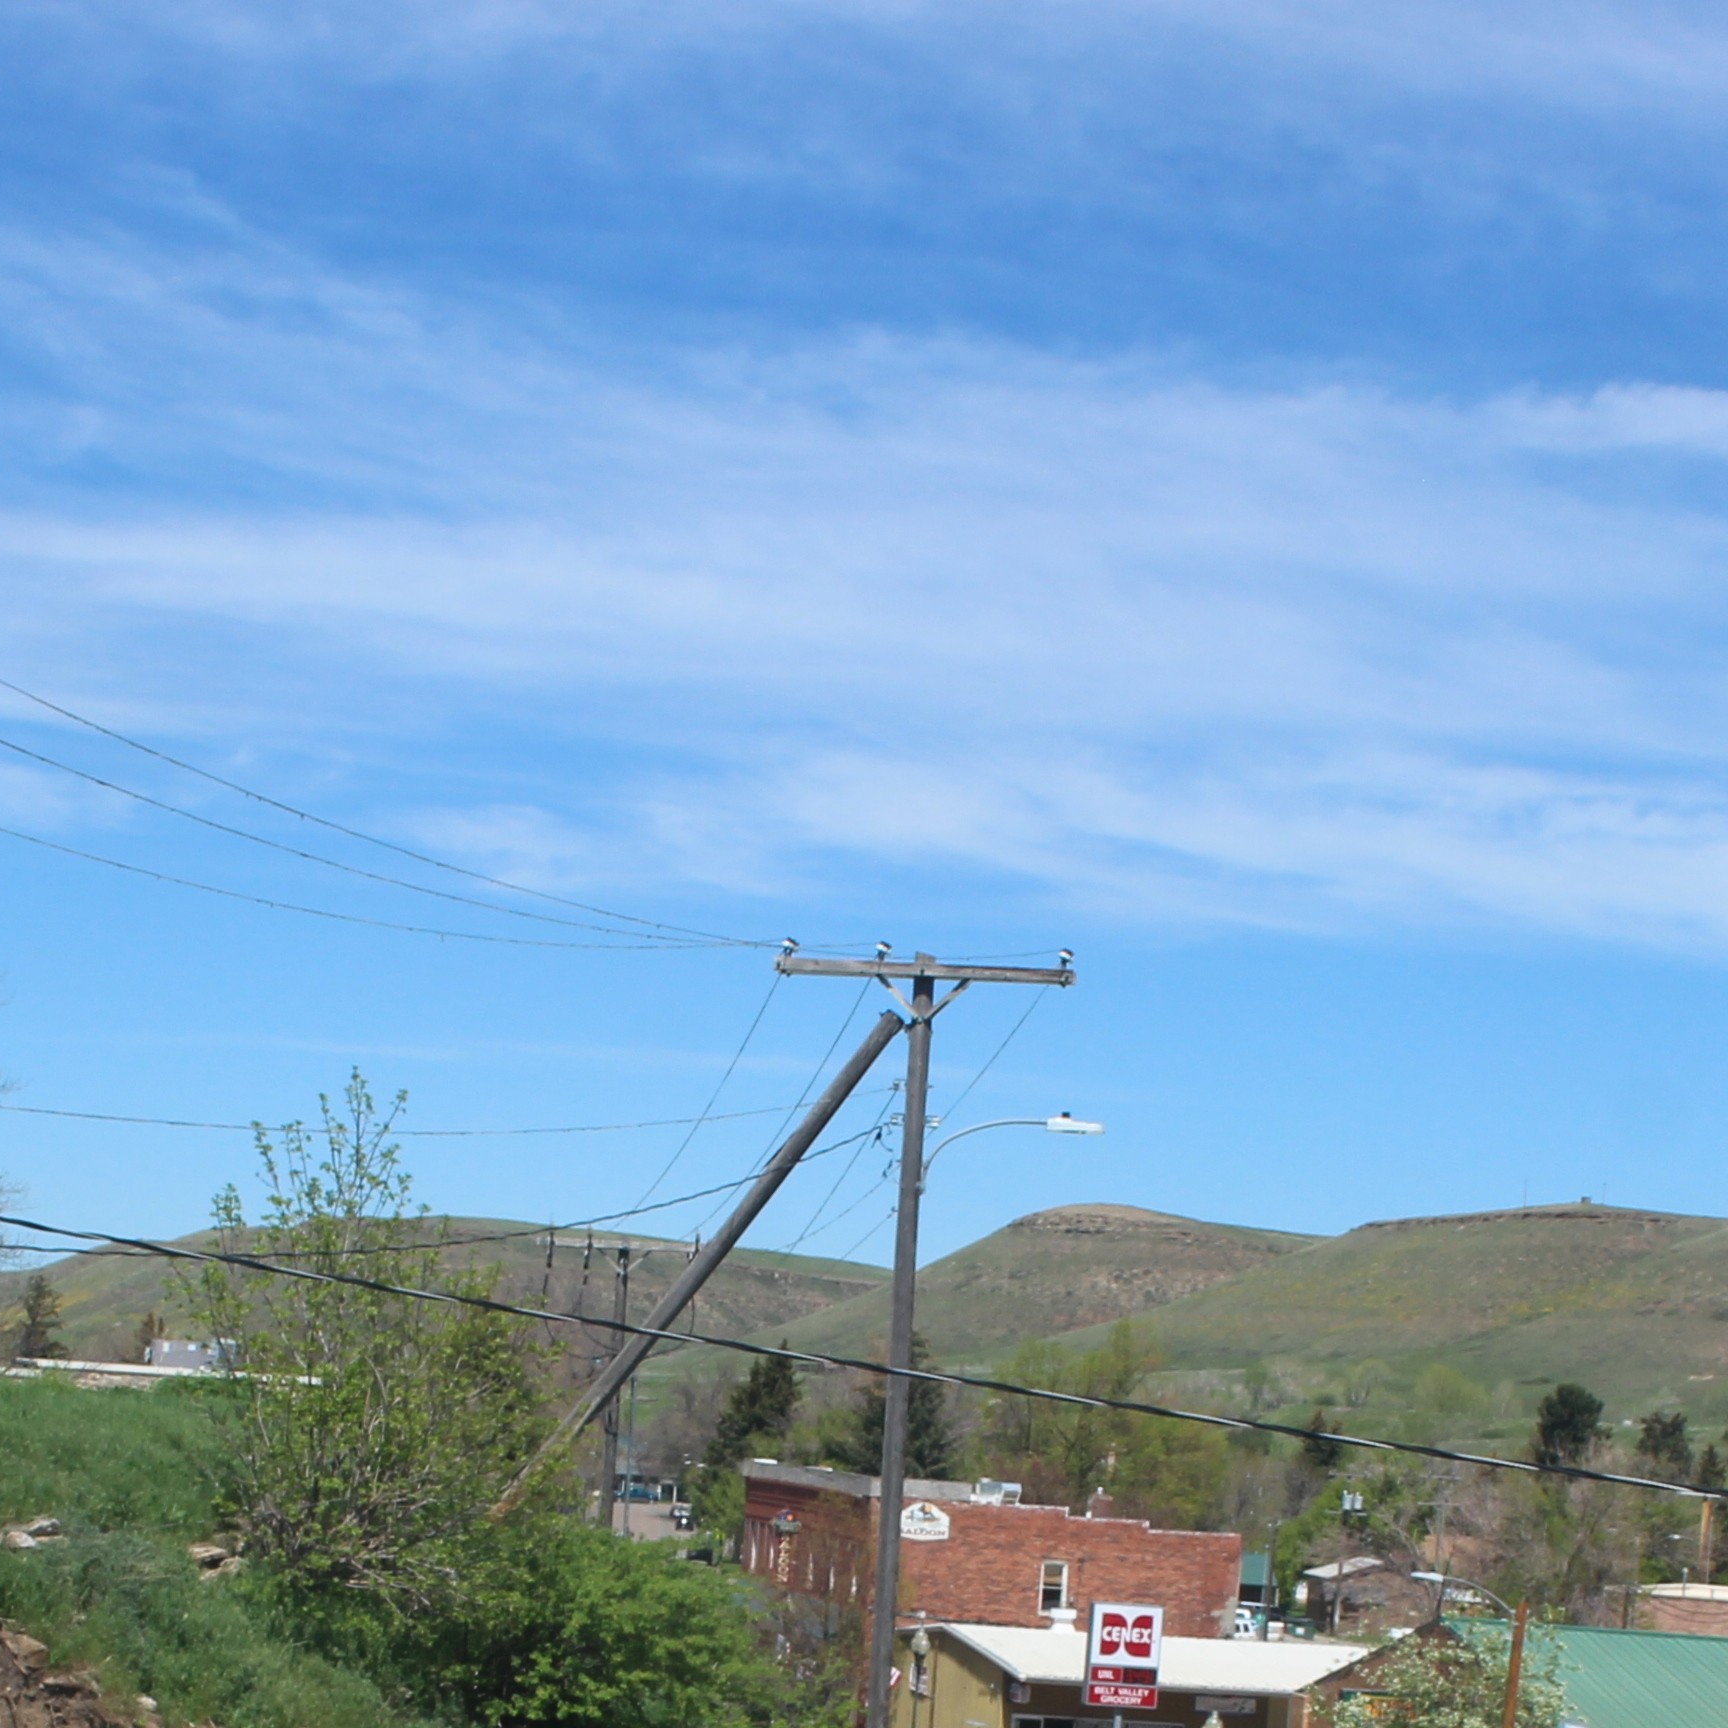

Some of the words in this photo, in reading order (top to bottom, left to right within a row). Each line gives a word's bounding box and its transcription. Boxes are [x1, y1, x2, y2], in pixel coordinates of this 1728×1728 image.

[1102, 1626, 1151, 1644] CENEX
[1094, 1686, 1115, 1696] BELT
[1118, 1688, 1150, 1698] VALLEY
[1100, 1695, 1143, 1705] GROCERY
